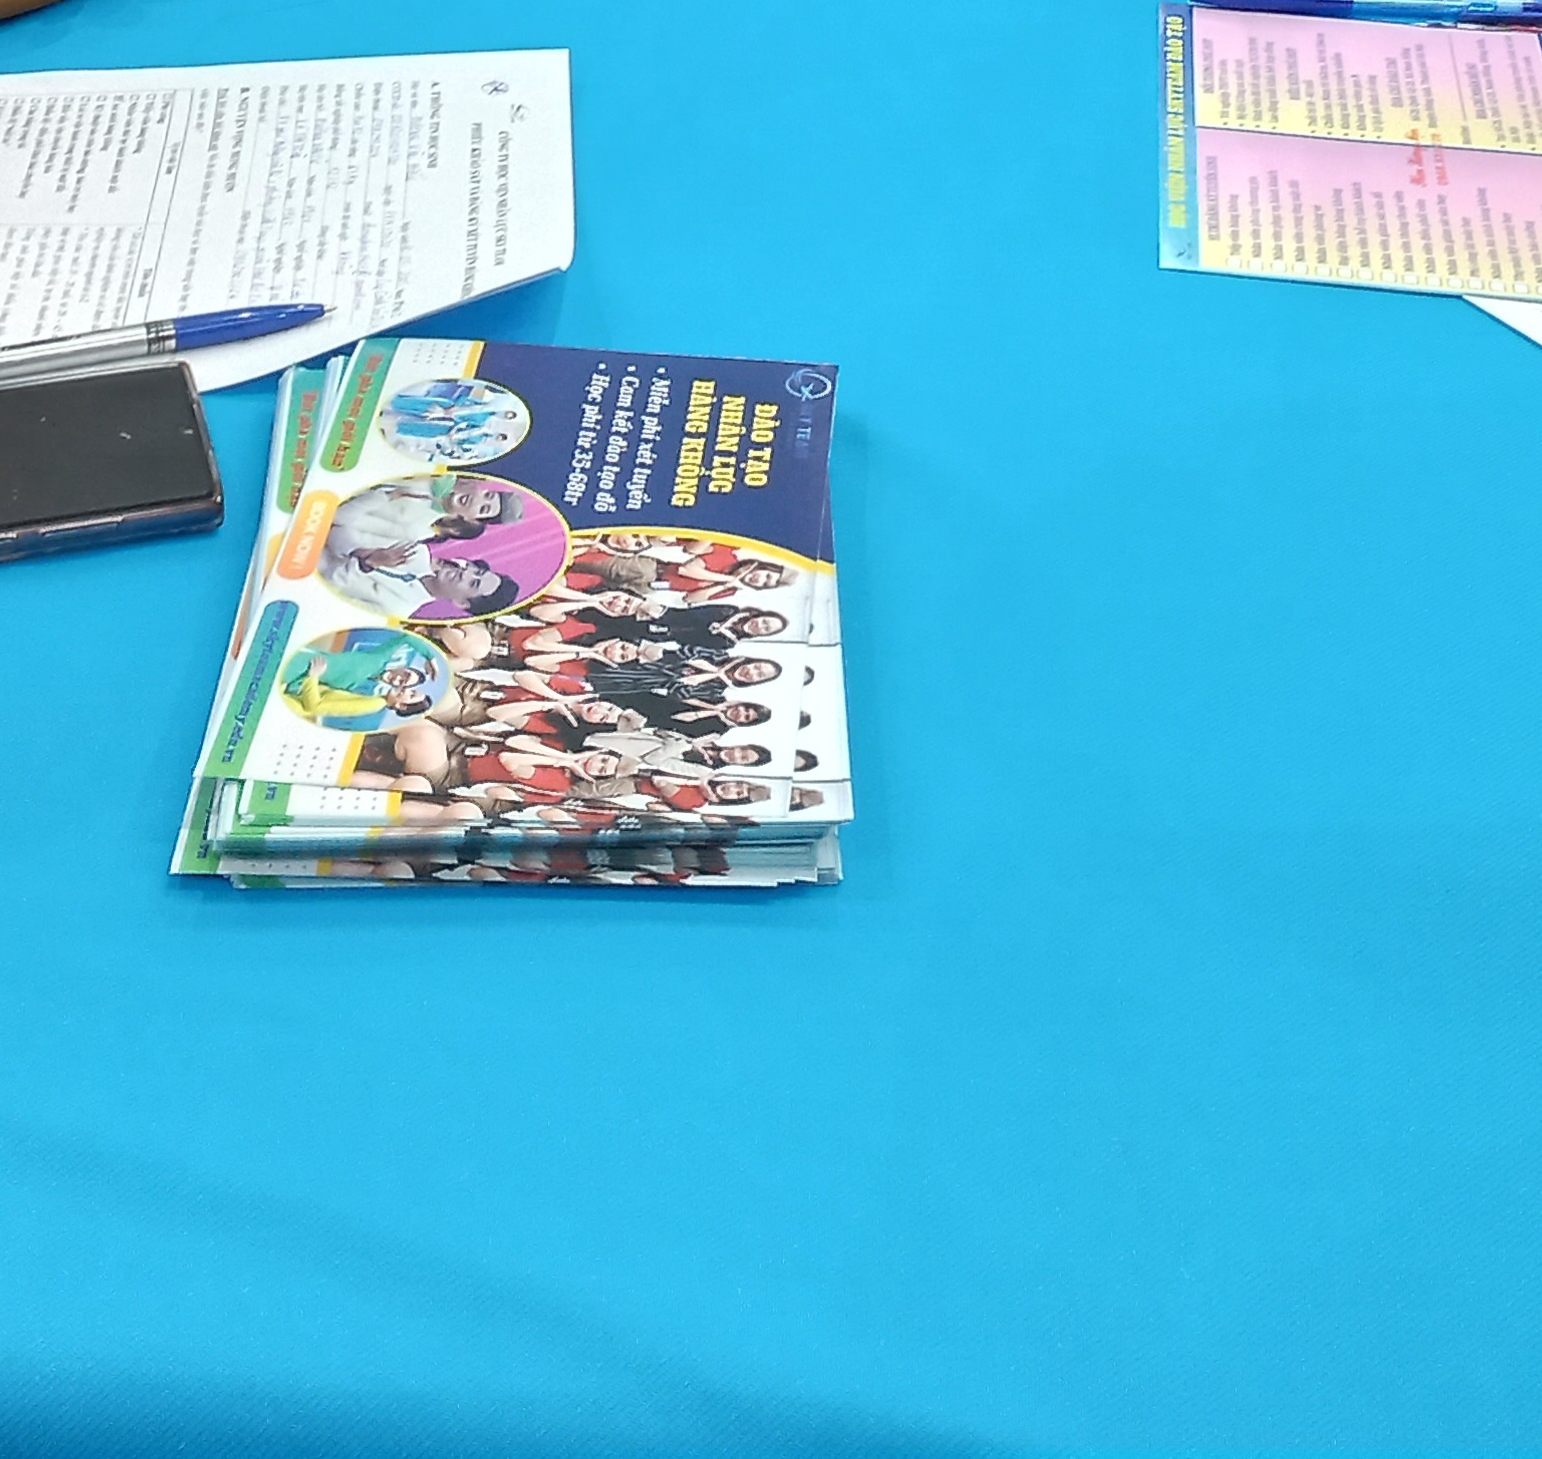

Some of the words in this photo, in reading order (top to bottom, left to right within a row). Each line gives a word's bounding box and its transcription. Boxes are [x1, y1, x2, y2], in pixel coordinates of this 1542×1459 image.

[1165, 13, 1186, 37] TẠO
[1163, 38, 1183, 60] ĐÀO
[1166, 61, 1184, 113] SKYTEAM
[586, 373, 610, 402] Học
[614, 374, 639, 408] Cam
[645, 377, 672, 414] Miễn
[578, 403, 604, 430] phí
[609, 409, 634, 434] kết
[684, 378, 718, 435] HÀNG
[637, 415, 663, 440] phí
[713, 393, 748, 453] NHÂN
[750, 402, 782, 445] ĐÀO
[576, 430, 596, 449] từ
[602, 434, 628, 463] đào
[634, 440, 658, 466] xét
[561, 447, 593, 507] 35-68tr
[594, 463, 619, 491] tạo
[669, 435, 708, 509] KHÔNG
[702, 453, 736, 495] LỰC
[737, 444, 772, 488] TẠO
[592, 491, 617, 513] đỗ
[622, 466, 654, 512] tuyển
[302, 501, 329, 534] BOOK
[292, 534, 317, 564] NOW
